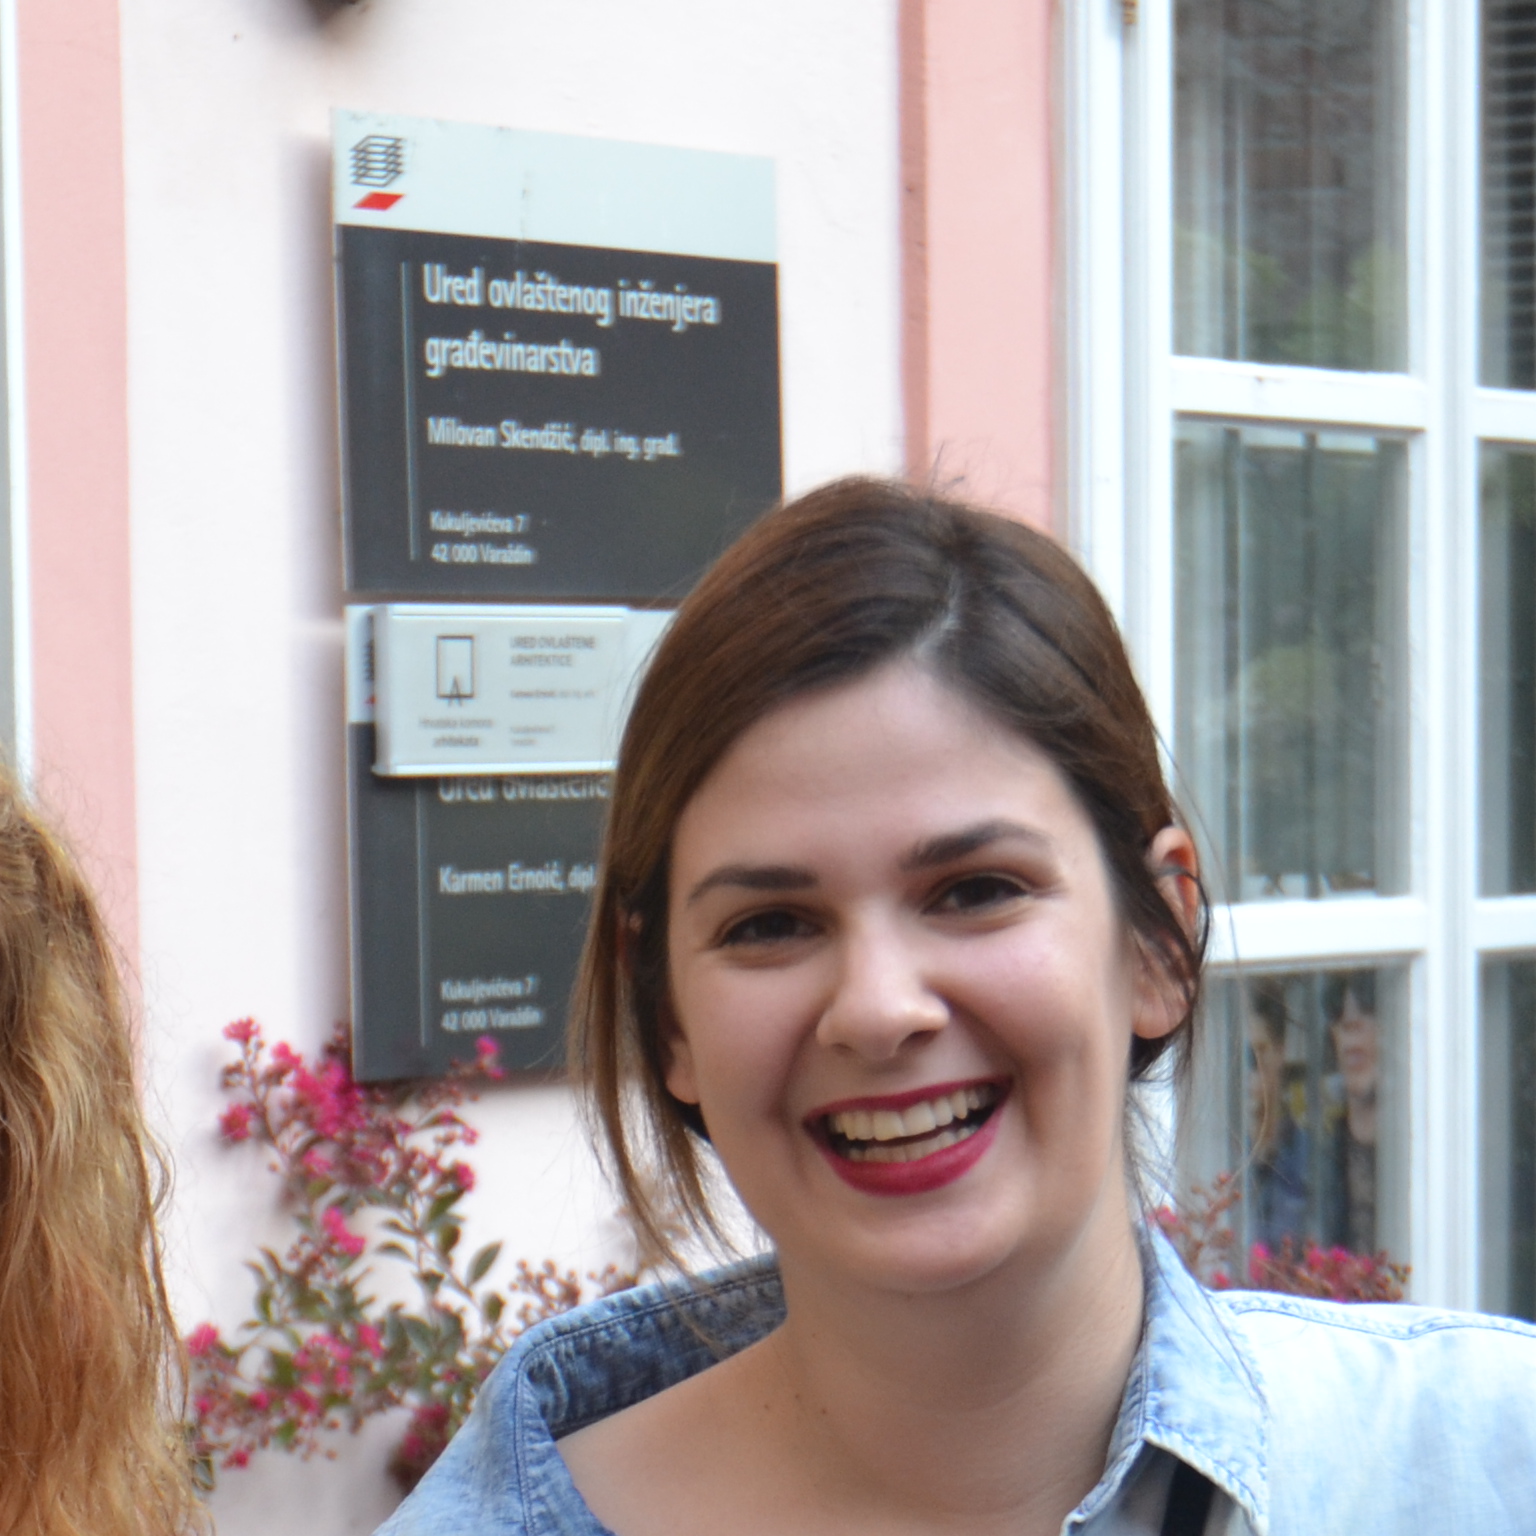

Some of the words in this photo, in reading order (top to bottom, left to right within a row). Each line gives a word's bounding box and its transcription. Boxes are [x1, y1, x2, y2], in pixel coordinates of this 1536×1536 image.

[423, 262, 483, 305] Ured
[488, 269, 614, 327] ovlaštenog
[618, 278, 721, 332] inženjera
[425, 329, 601, 378] građevinarstva
[427, 416, 496, 447] Milovan
[516, 513, 530, 532] 7
[431, 543, 449, 562] 42
[451, 544, 478, 563] 000
[480, 543, 534, 564] Varaždin
[439, 864, 504, 893] Karmen
[525, 974, 538, 995] 7
[442, 1010, 459, 1031] 42
